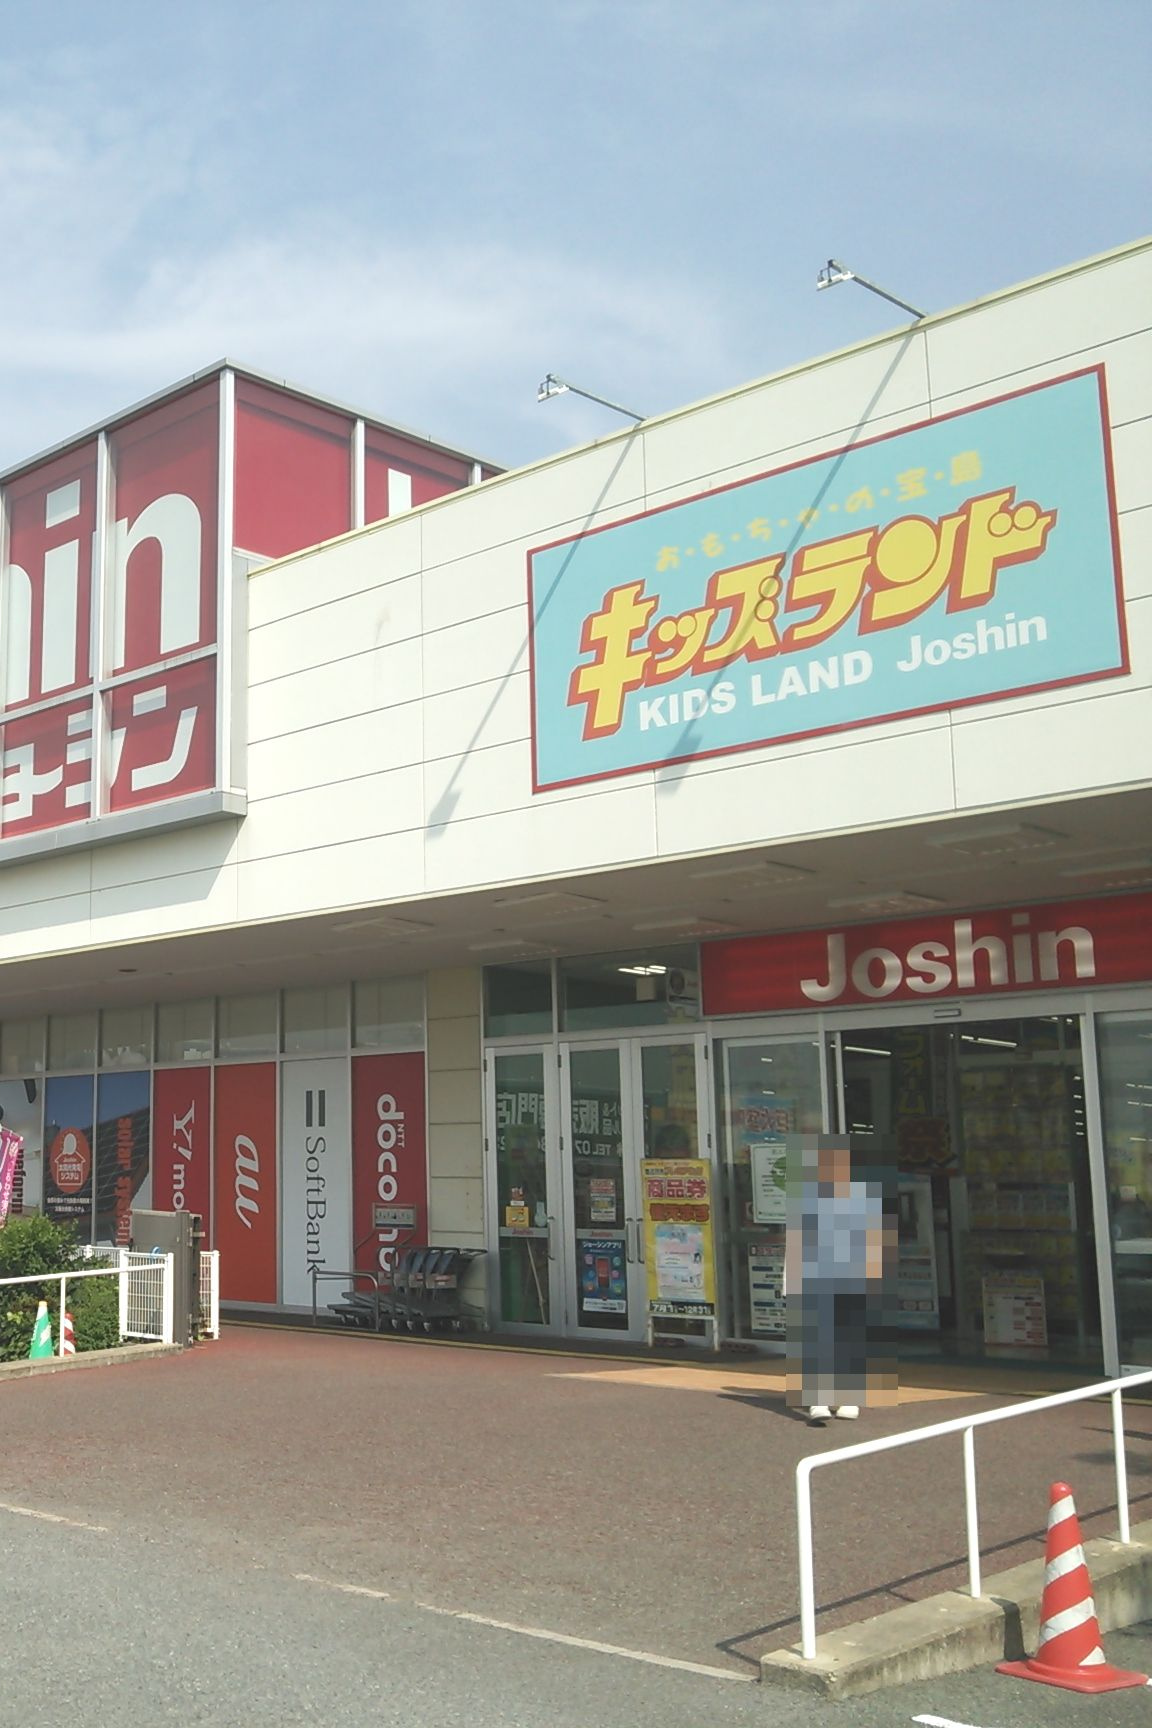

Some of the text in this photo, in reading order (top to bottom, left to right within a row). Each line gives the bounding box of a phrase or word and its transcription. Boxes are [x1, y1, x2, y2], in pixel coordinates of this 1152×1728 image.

[570, 487, 1056, 738] キッズランド
[639, 612, 1047, 731] KIDS LAND Joshin
[800, 914, 1095, 1001] Joshin
[234, 1134, 259, 1229] au
[306, 1136, 327, 1274] SoftBank
[647, 1179, 707, 1199] 商品券
